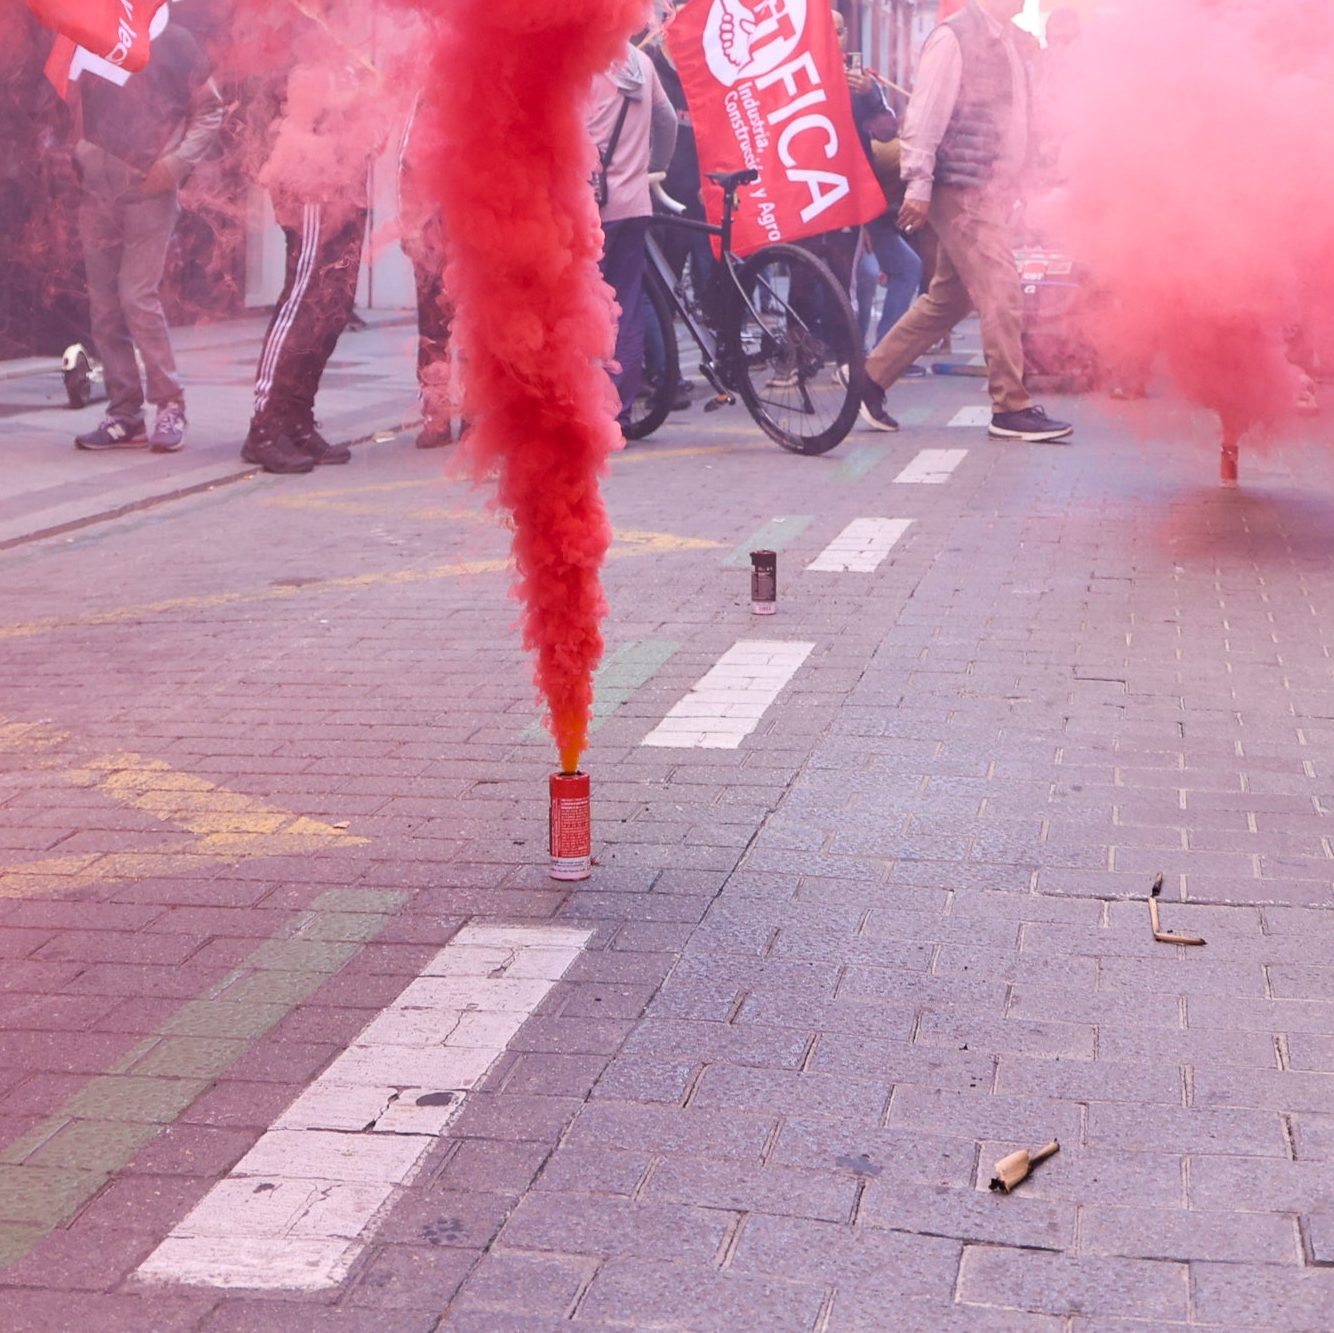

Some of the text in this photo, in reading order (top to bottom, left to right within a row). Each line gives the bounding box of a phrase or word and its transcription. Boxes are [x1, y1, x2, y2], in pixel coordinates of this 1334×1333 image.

[737, 81, 769, 153] Industria,
[755, 50, 851, 224] FICA
[749, 187, 768, 198] y
[757, 202, 782, 242] Agro
